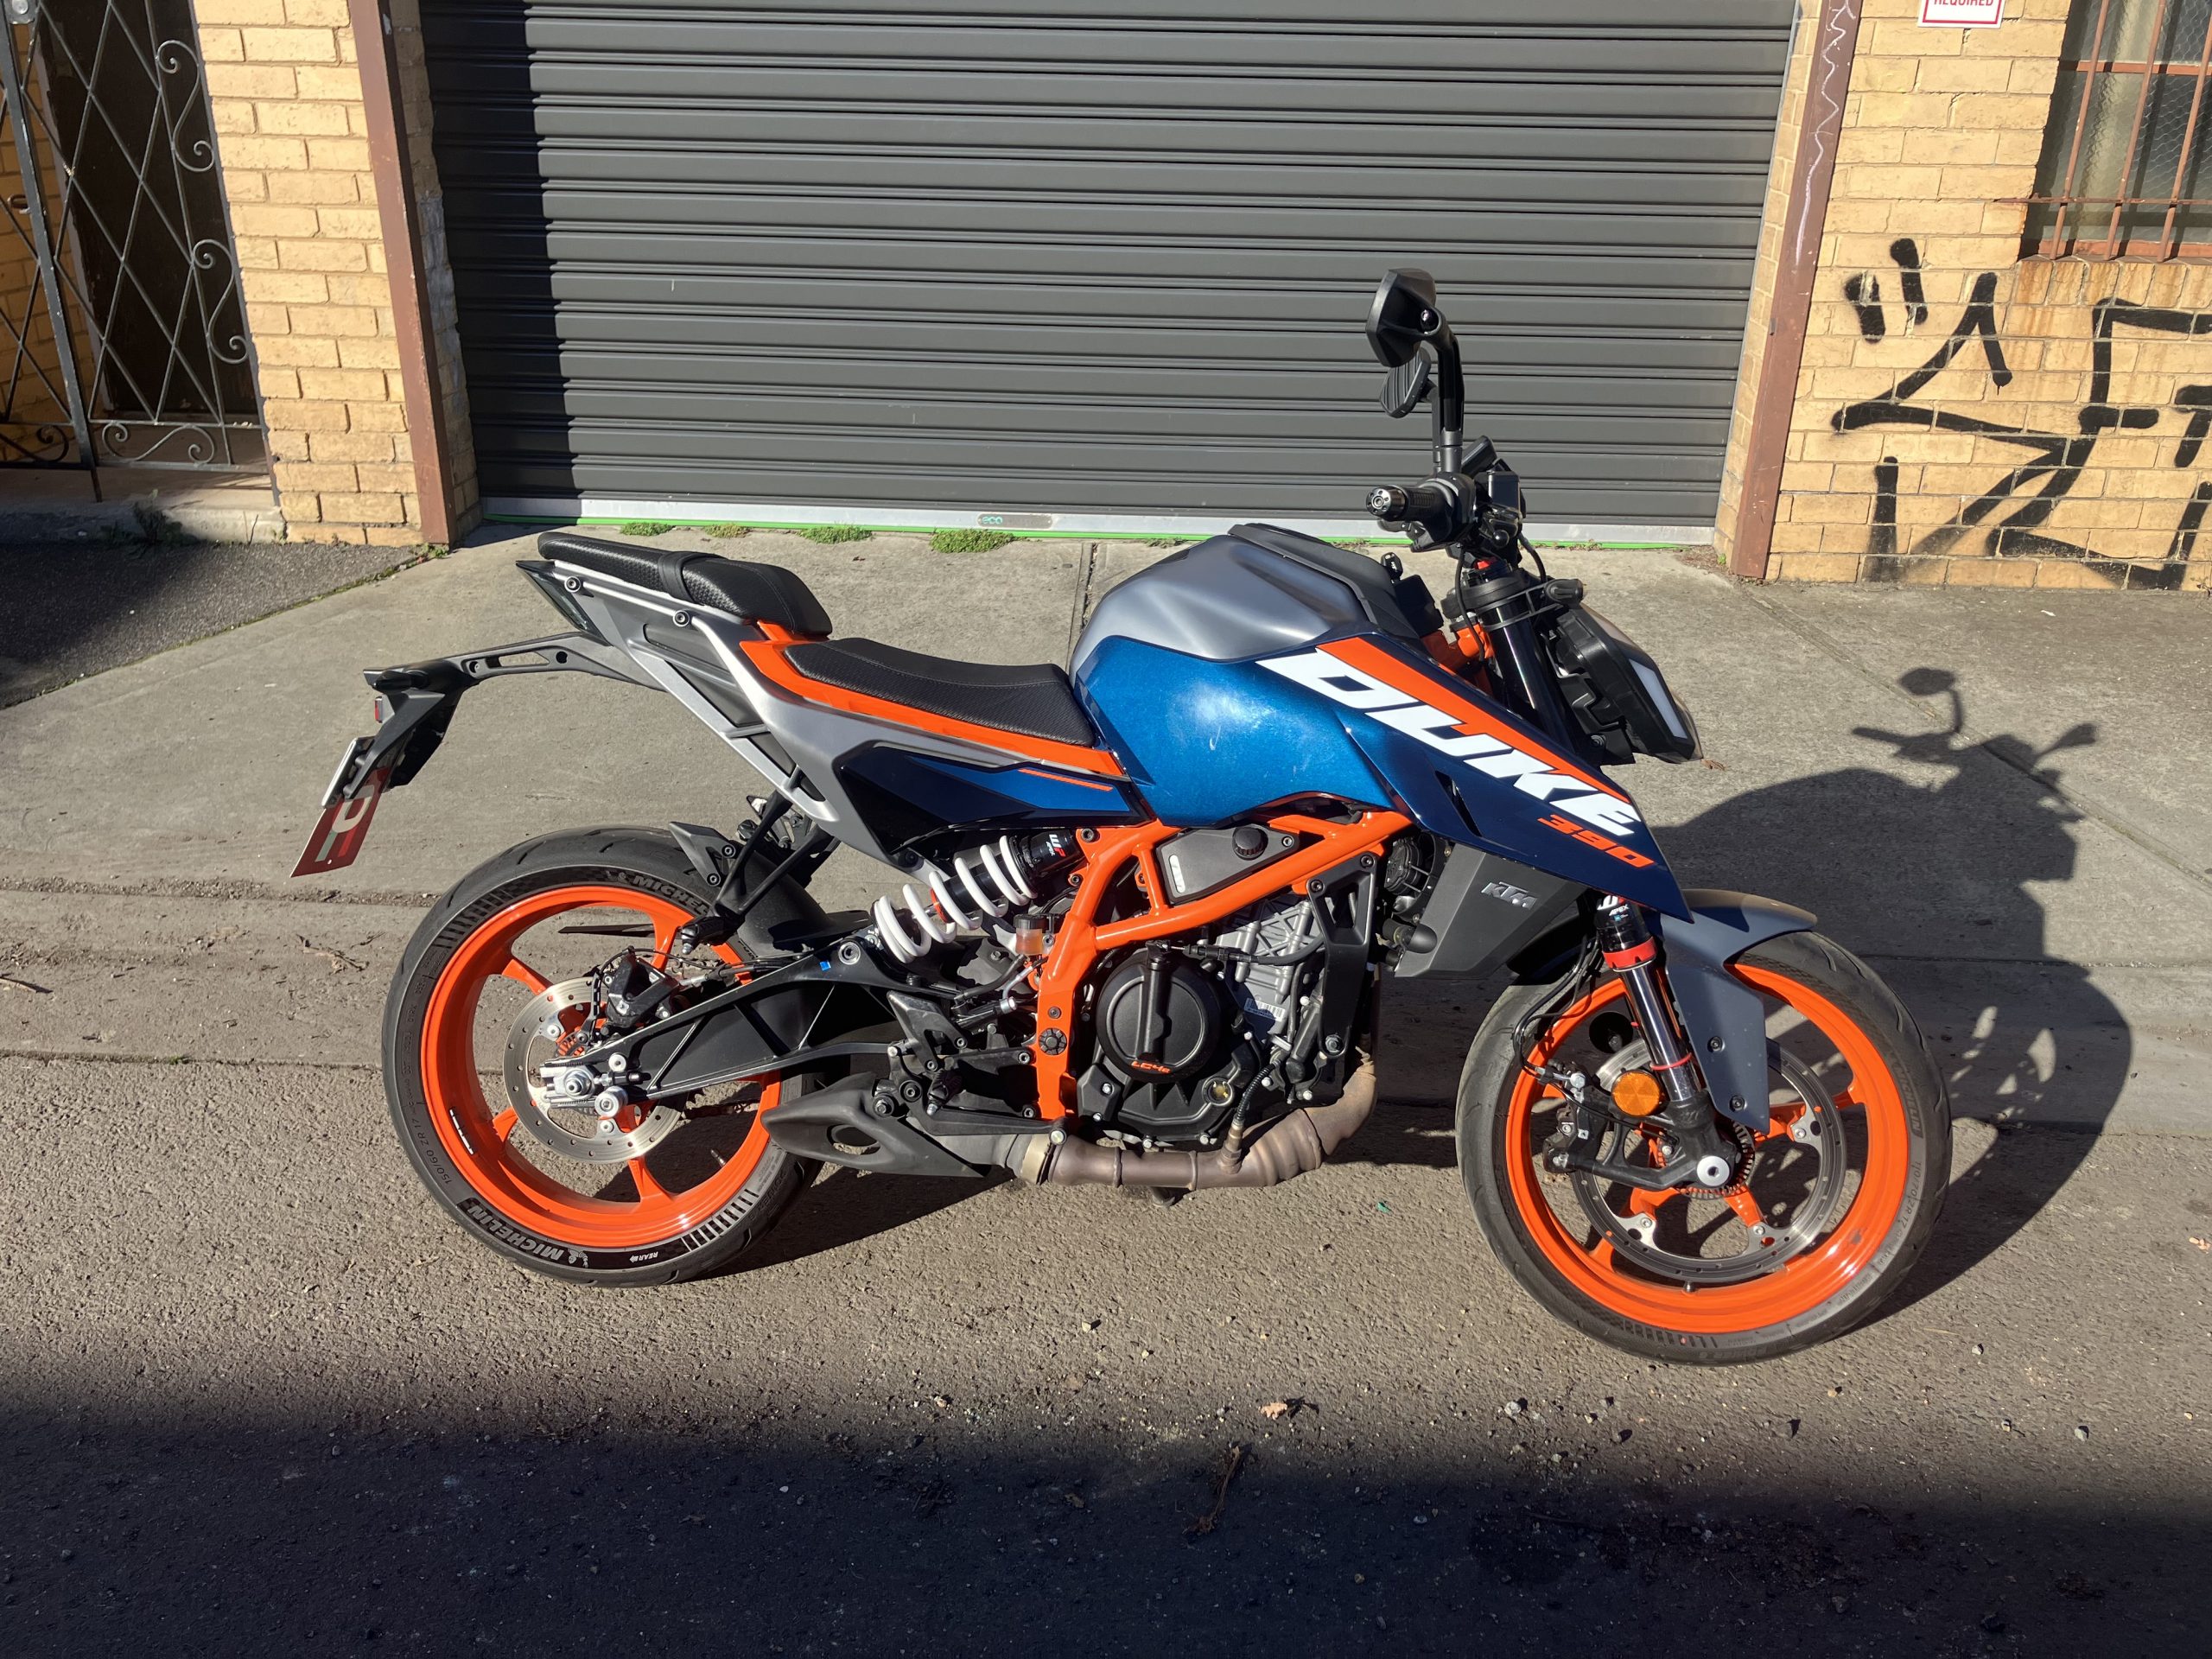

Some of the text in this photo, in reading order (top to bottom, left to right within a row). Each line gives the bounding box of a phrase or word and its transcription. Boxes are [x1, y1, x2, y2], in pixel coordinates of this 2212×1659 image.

[1255, 648, 1642, 836] DUKE
[1049, 834, 1066, 857] WP
[1537, 814, 1655, 868] 390
[632, 874, 710, 914] MICHEL
[1481, 881, 1538, 910] KTM
[1609, 904, 1629, 916] APEX
[411, 1118, 452, 1184] 150/60 ZR 17
[467, 1205, 565, 1262] MICHELIN
[638, 1251, 659, 1262] REAR
